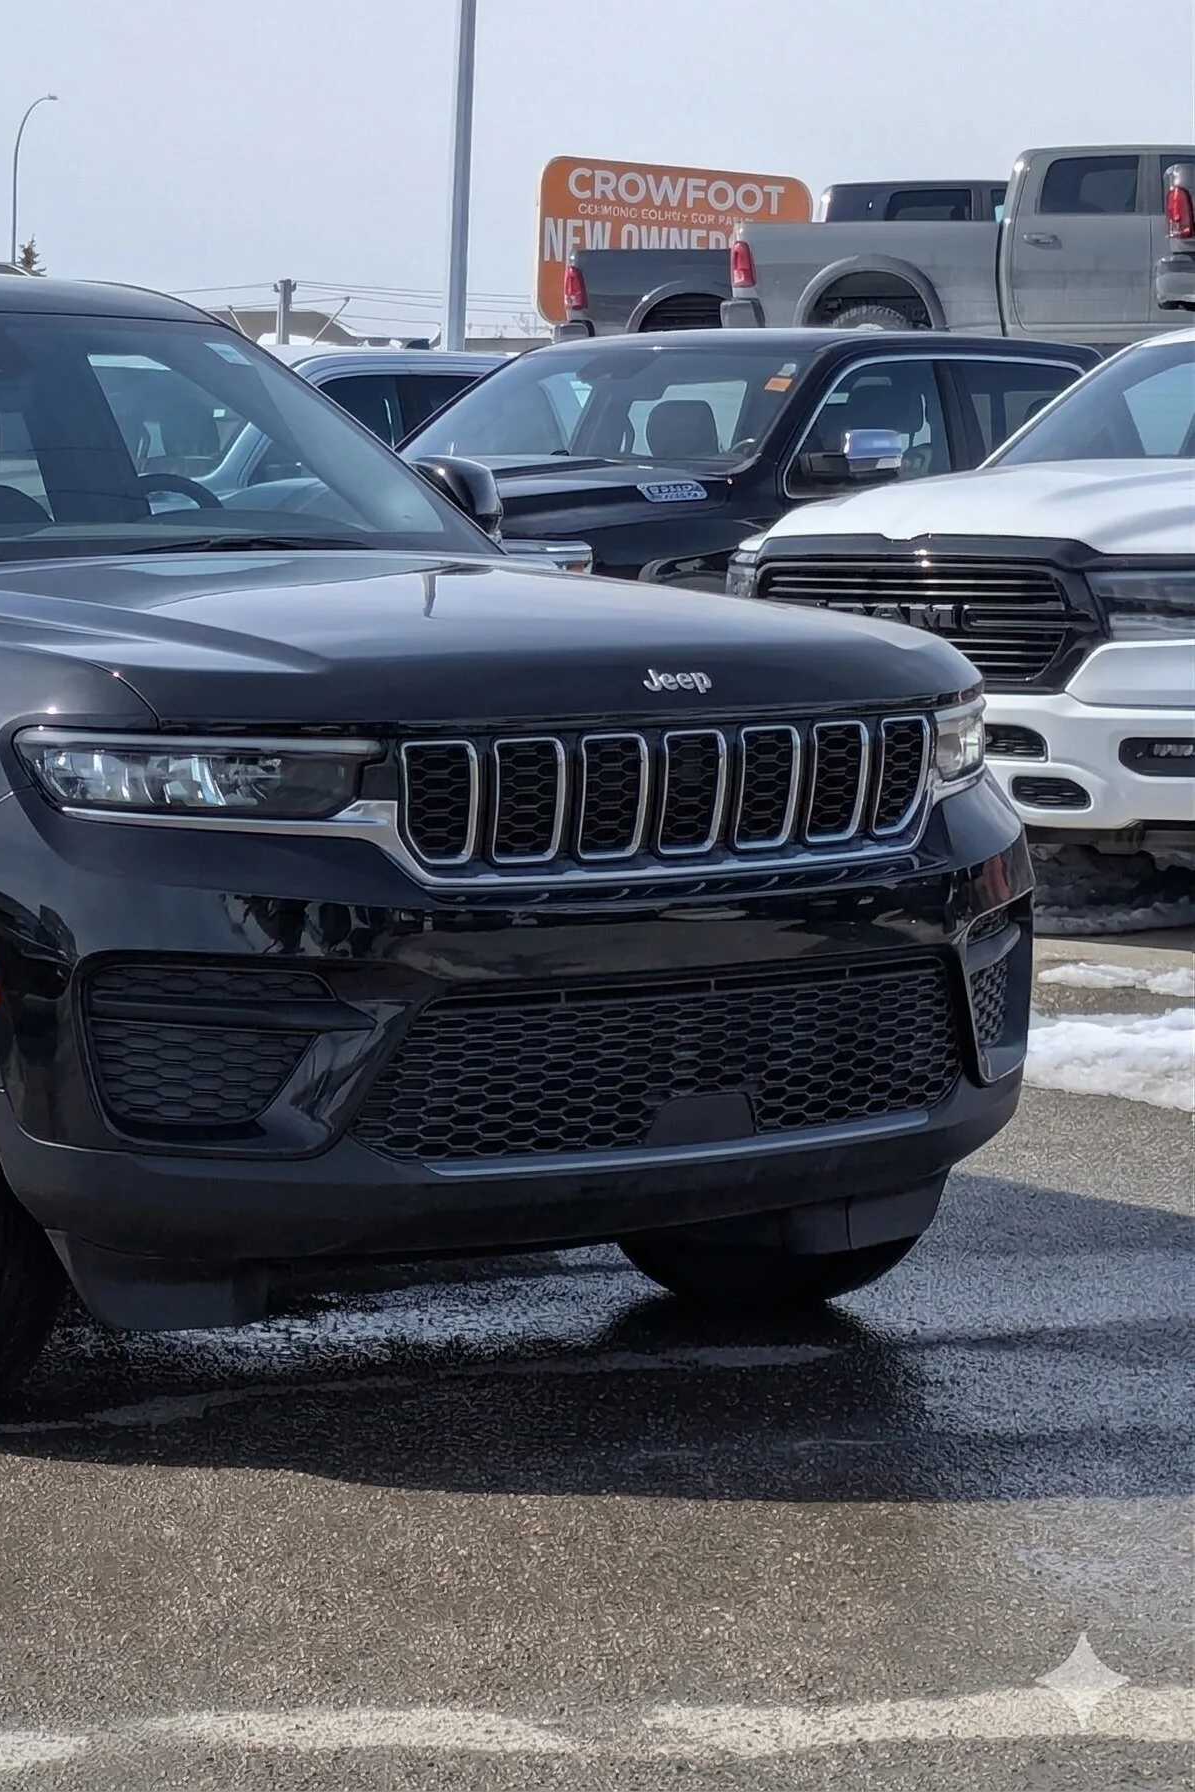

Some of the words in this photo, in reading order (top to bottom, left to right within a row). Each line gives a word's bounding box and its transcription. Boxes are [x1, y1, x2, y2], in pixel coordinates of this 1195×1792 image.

[568, 167, 785, 215] CROWFOOT
[544, 217, 612, 263] NEW
[827, 602, 958, 629] AM
[643, 668, 712, 694] Jeep
